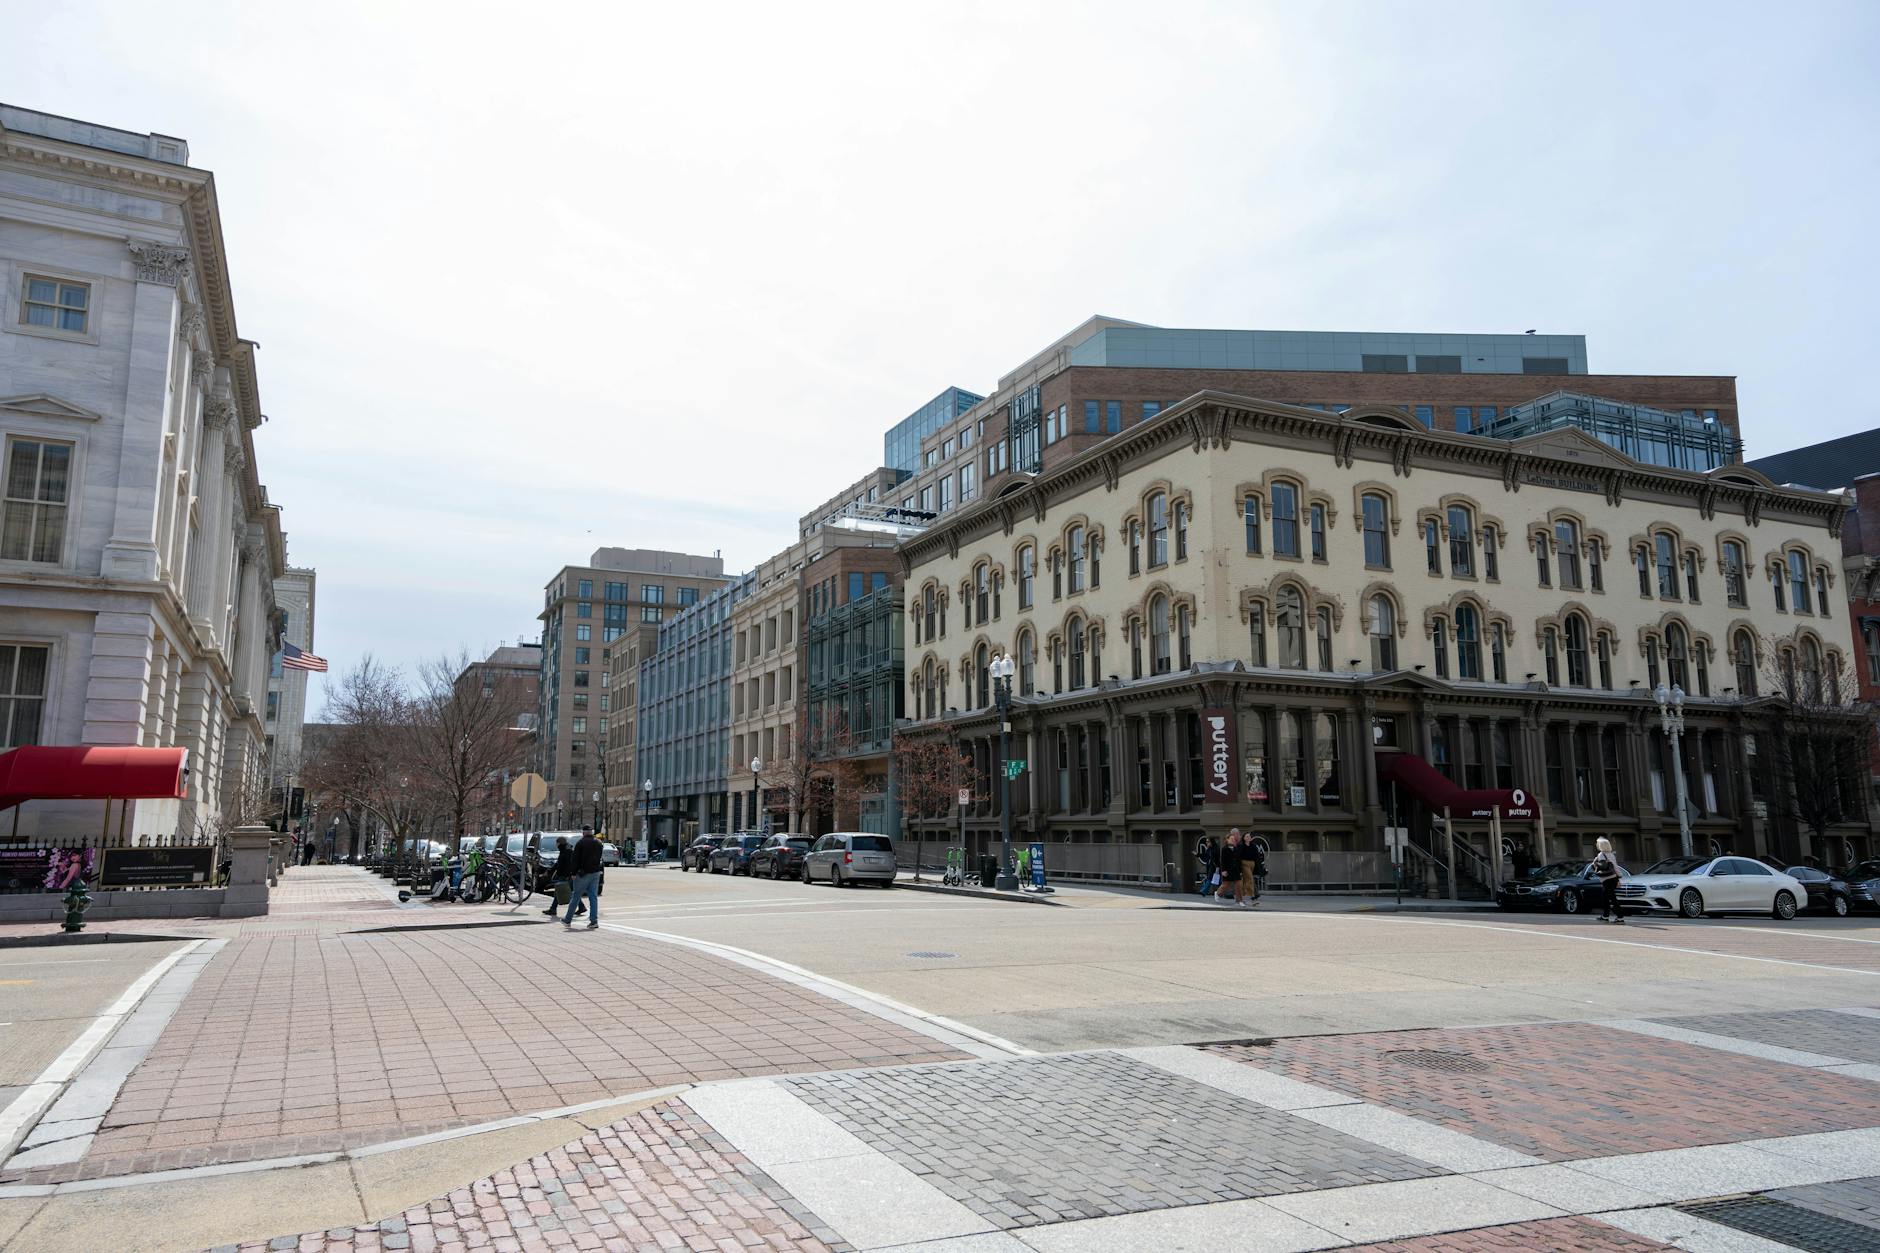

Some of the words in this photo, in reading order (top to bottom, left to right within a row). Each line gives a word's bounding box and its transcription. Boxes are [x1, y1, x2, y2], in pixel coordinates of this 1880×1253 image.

[1558, 479, 1599, 492] BUILDING
[1207, 716, 1229, 795] puttery
[1508, 808, 1532, 817] puttery
